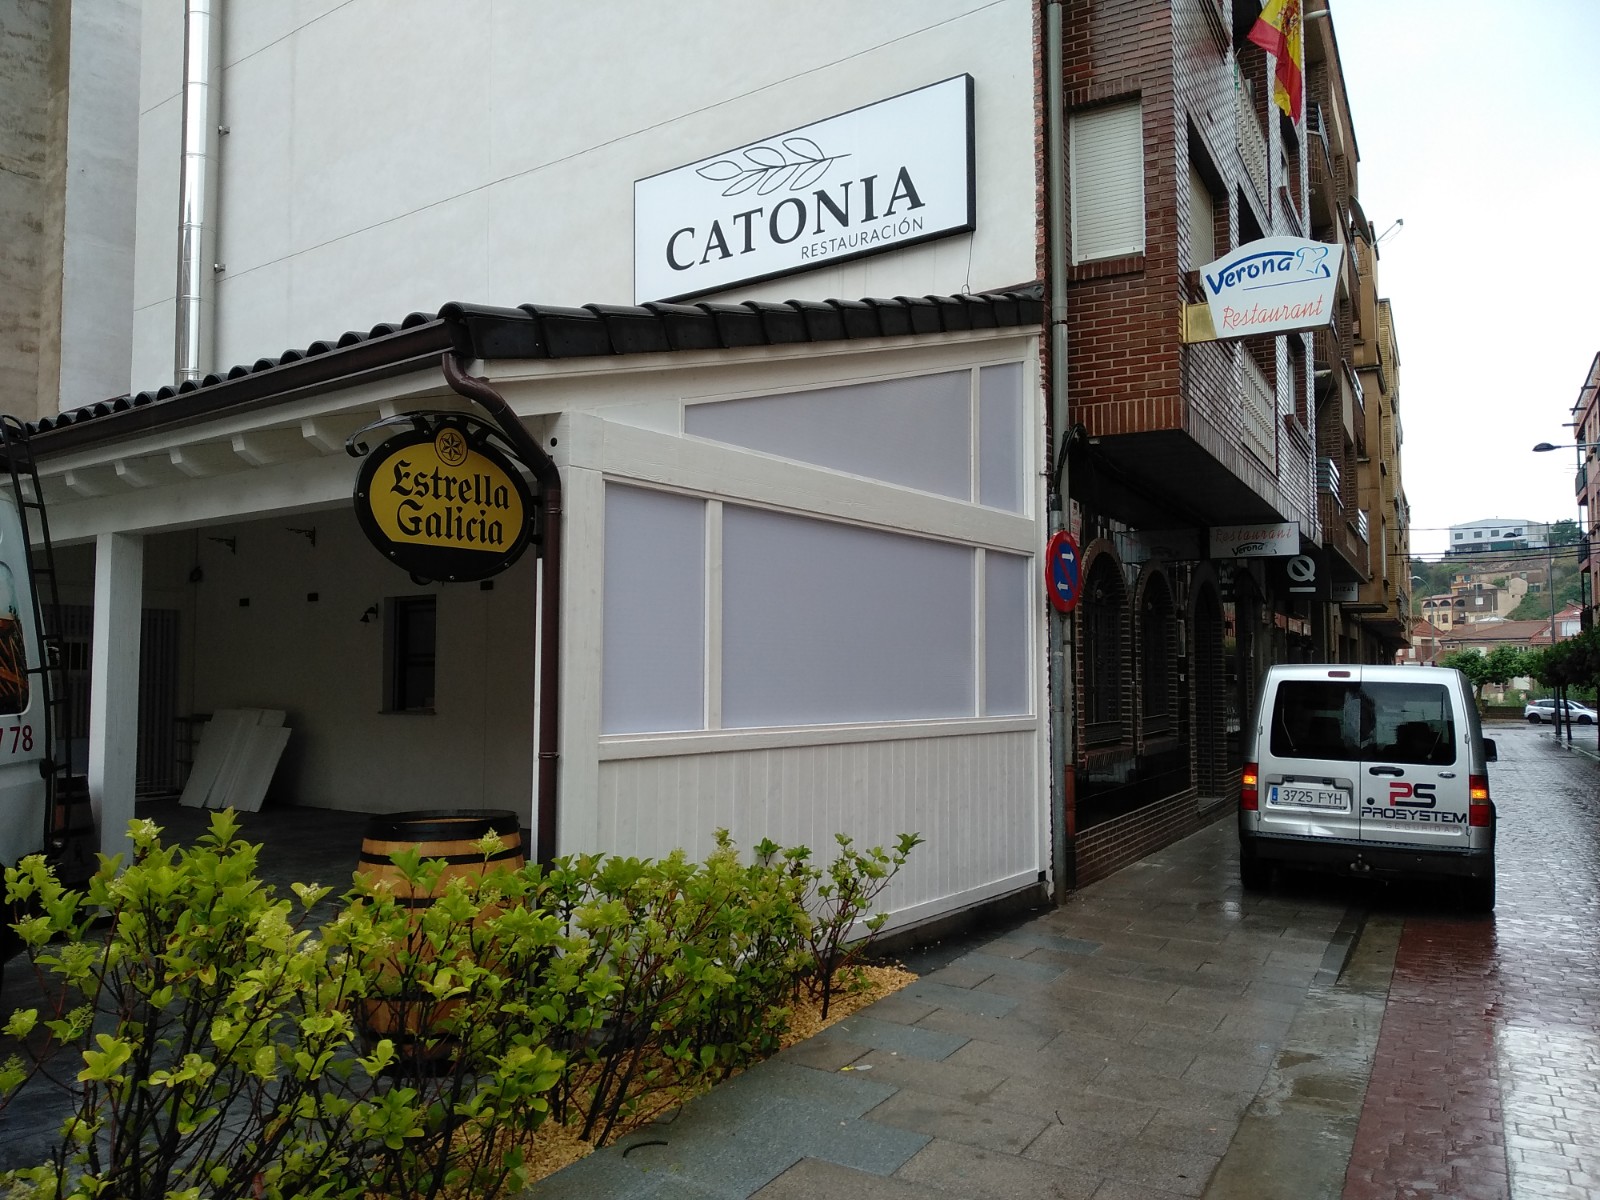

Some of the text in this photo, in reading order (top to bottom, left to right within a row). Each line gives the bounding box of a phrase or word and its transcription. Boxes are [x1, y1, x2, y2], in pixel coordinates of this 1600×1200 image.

[666, 166, 925, 271] CATONIA
[801, 216, 924, 260] RESTAURACIÓN
[1205, 251, 1295, 296] Verona
[1222, 294, 1323, 330] Restaurant
[390, 459, 511, 510] Estrella
[396, 499, 504, 545] Galicia
[1215, 526, 1293, 544] Restaurant
[1231, 542, 1265, 556] Verona
[1283, 790, 1342, 805] 3725 FYH
[1389, 782, 1437, 808] PS
[1361, 807, 1467, 824] PROSYSTEM
[1386, 822, 1459, 833] SEGURIDAD
